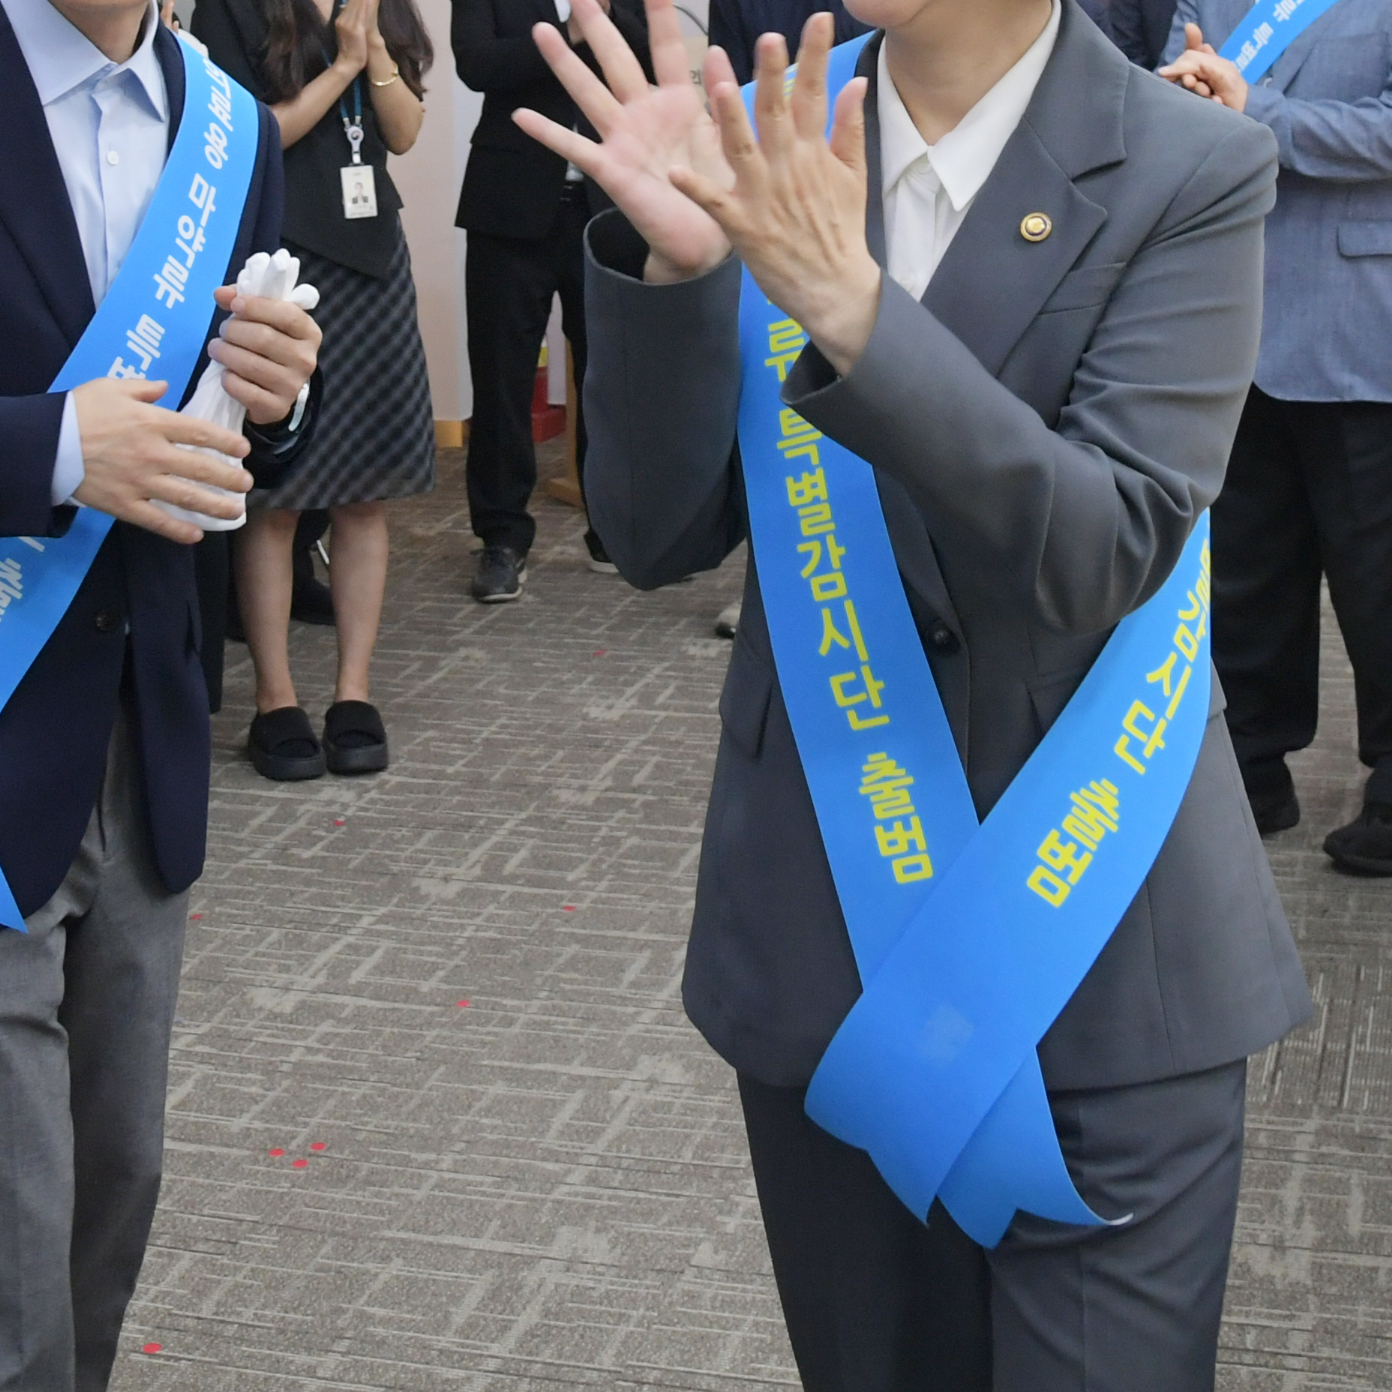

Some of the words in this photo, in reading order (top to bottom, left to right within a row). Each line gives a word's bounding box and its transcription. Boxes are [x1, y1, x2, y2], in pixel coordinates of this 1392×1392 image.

[153, 172, 217, 309] 마약류
[858, 751, 934, 885] 출범
[1026, 777, 1120, 908] 출범
